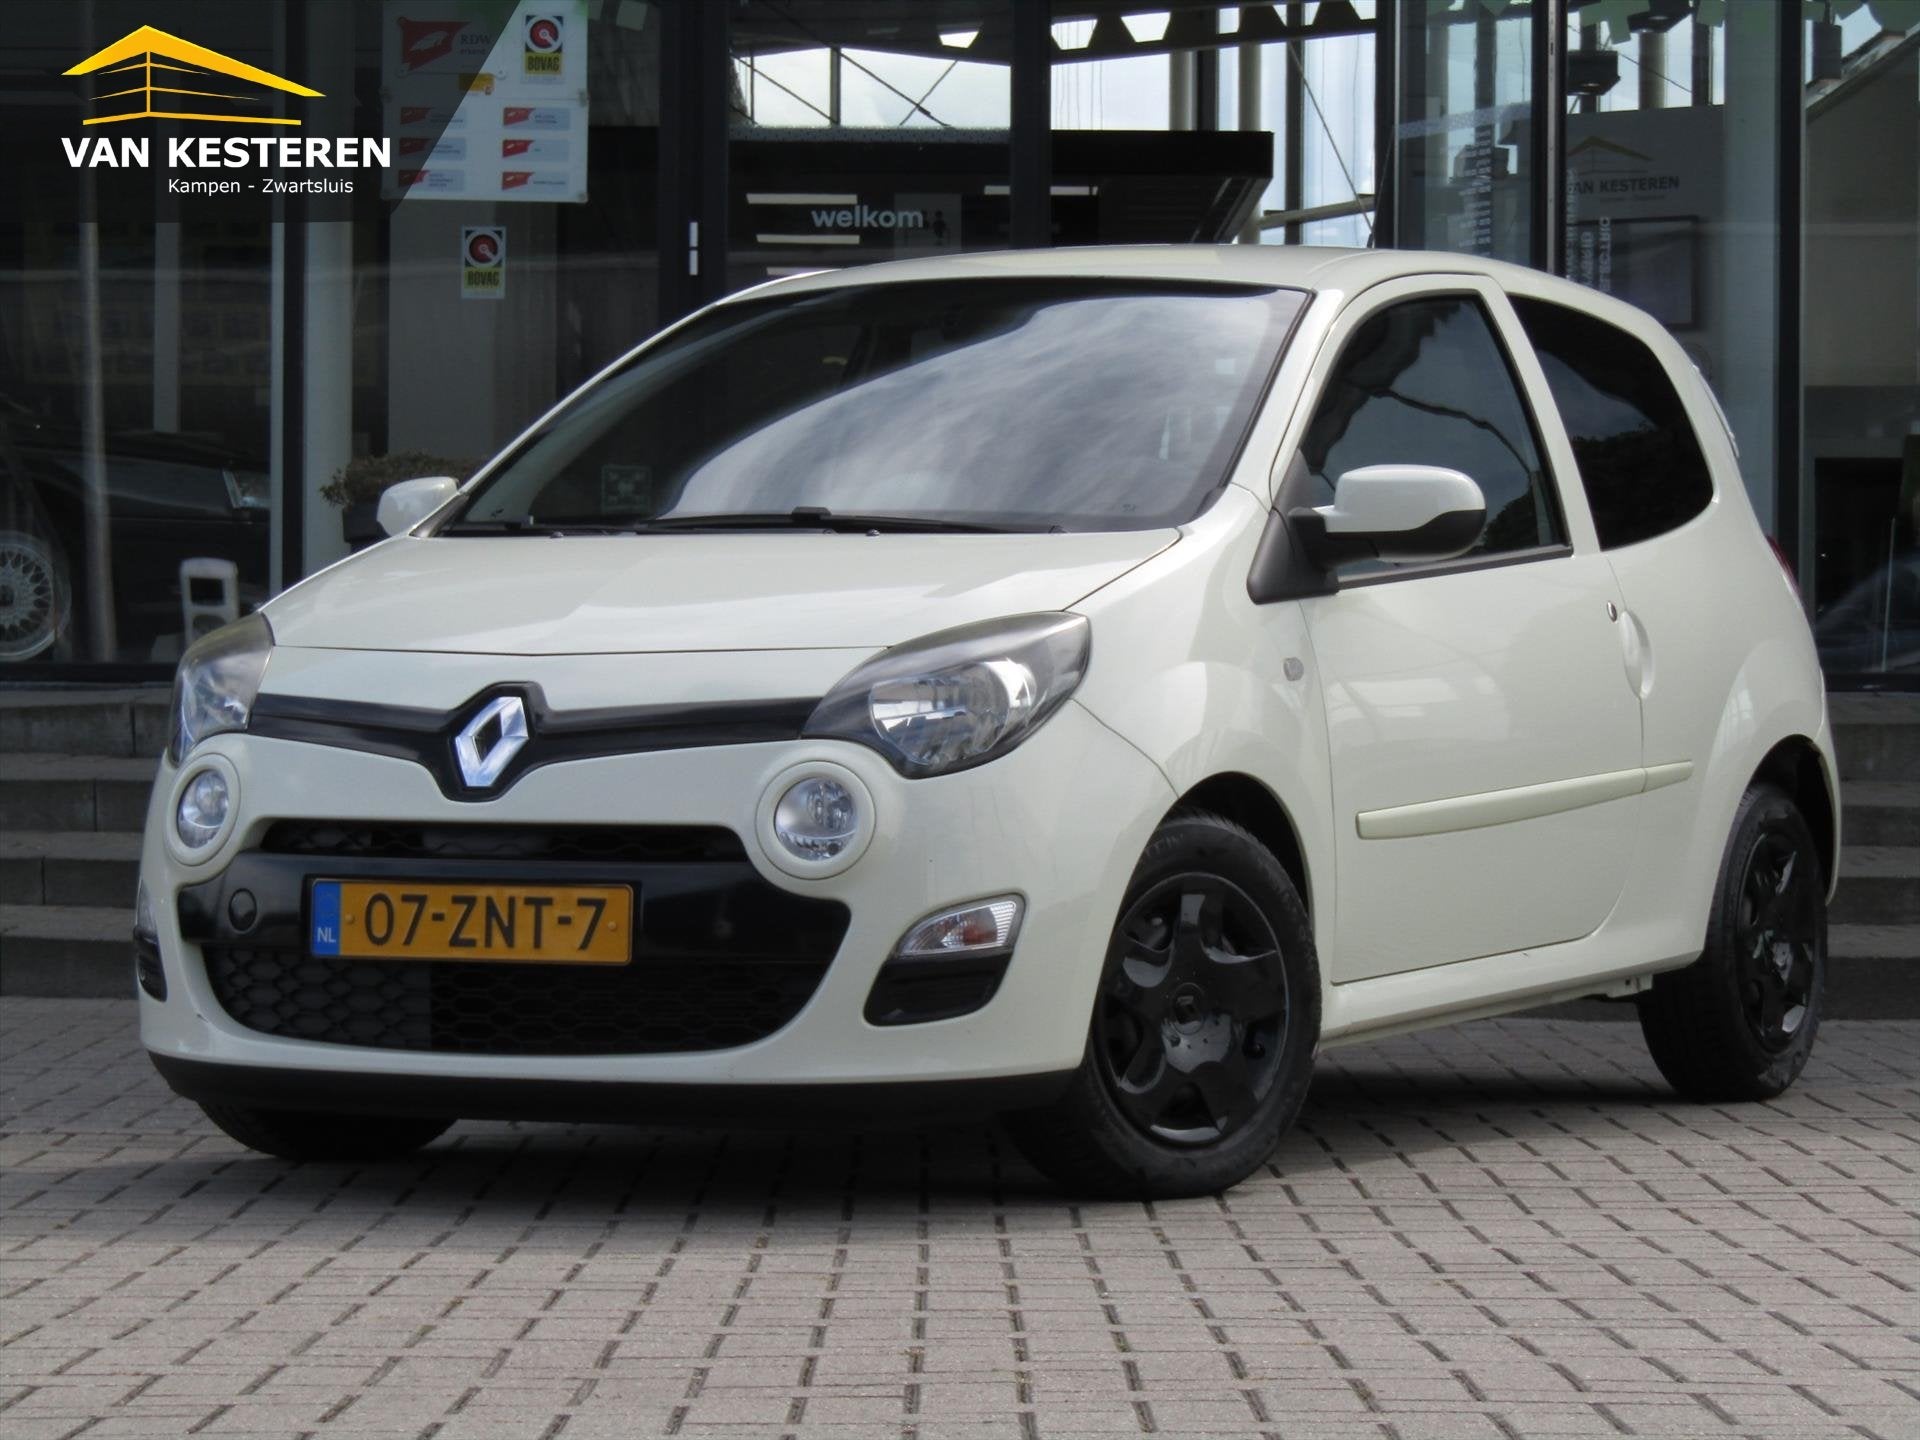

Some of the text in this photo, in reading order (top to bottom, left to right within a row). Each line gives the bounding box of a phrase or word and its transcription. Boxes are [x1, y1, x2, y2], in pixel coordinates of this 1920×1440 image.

[527, 55, 560, 72] BOVAG
[1600, 176, 1679, 193] KESTEREN
[811, 205, 924, 228] welkom
[467, 271, 500, 287] BOVAG
[364, 892, 607, 950] 07-ZNT-7
[317, 927, 336, 943] NL
